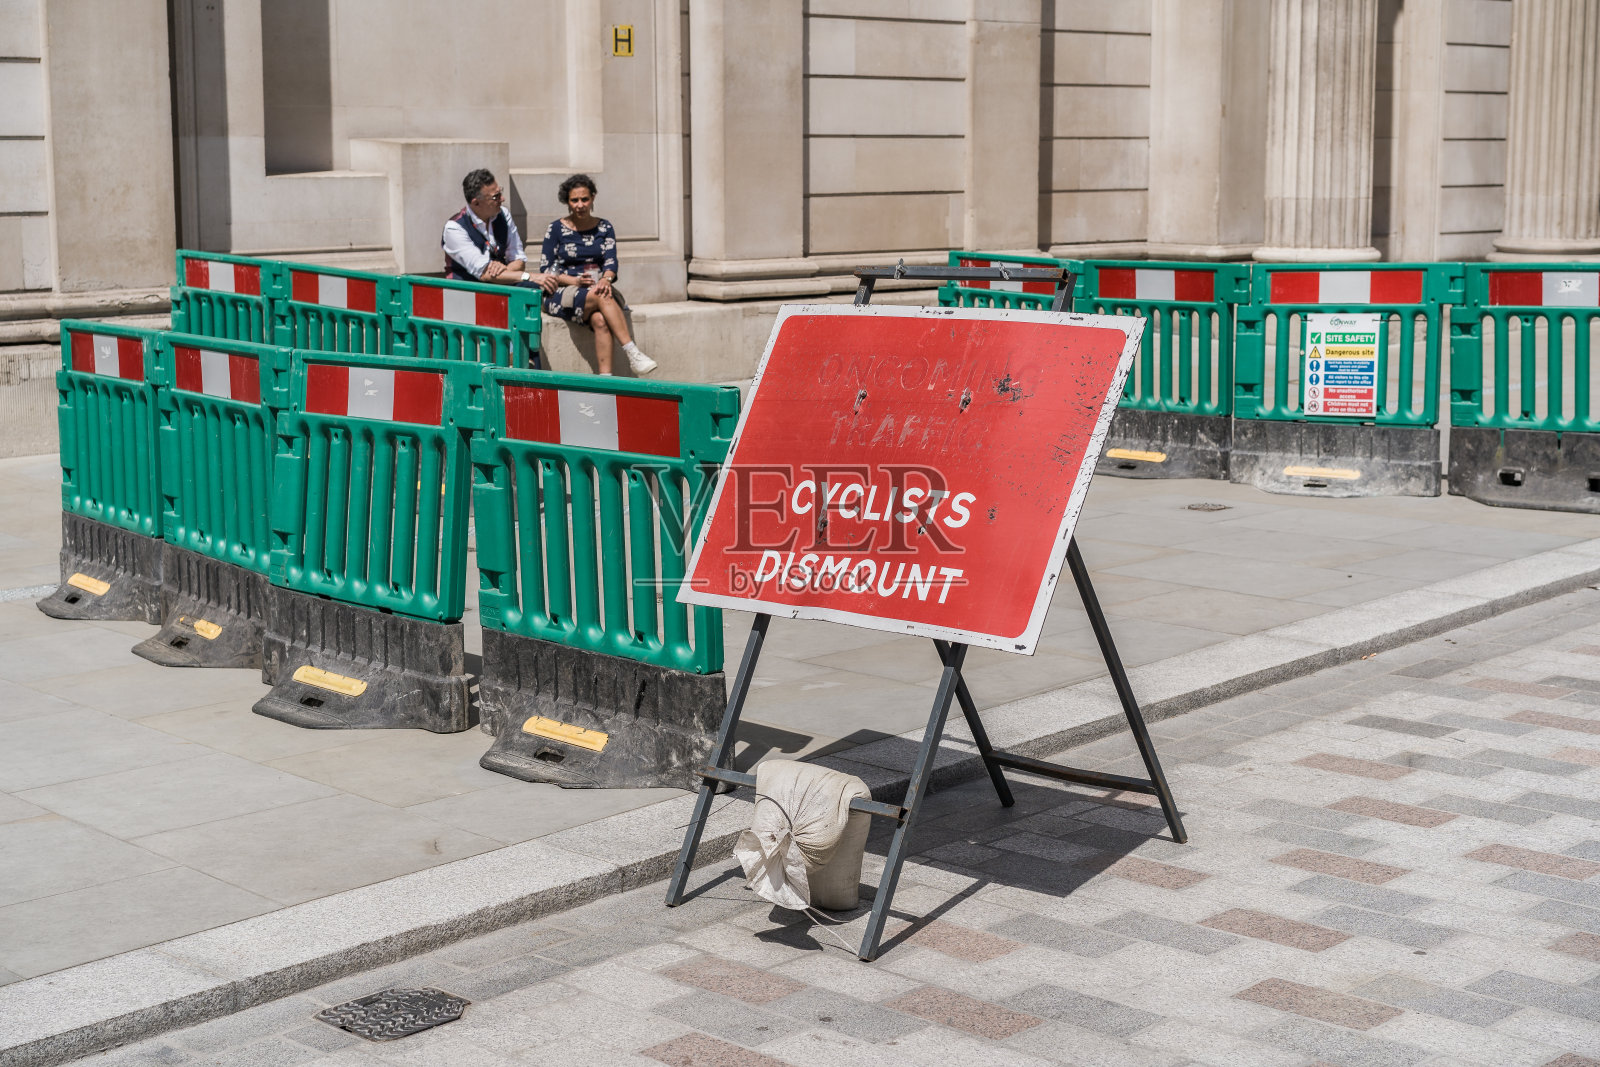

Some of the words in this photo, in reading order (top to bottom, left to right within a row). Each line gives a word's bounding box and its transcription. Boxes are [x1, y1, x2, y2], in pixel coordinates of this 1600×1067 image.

[615, 28, 631, 53] H
[1330, 318, 1357, 327] CONWAY
[1326, 334, 1343, 343] SITE
[1345, 334, 1374, 343] SAFETY
[1325, 348, 1360, 356] Dangerous
[791, 479, 977, 529] CYCLISTS
[754, 548, 964, 604] DISMOUNT
